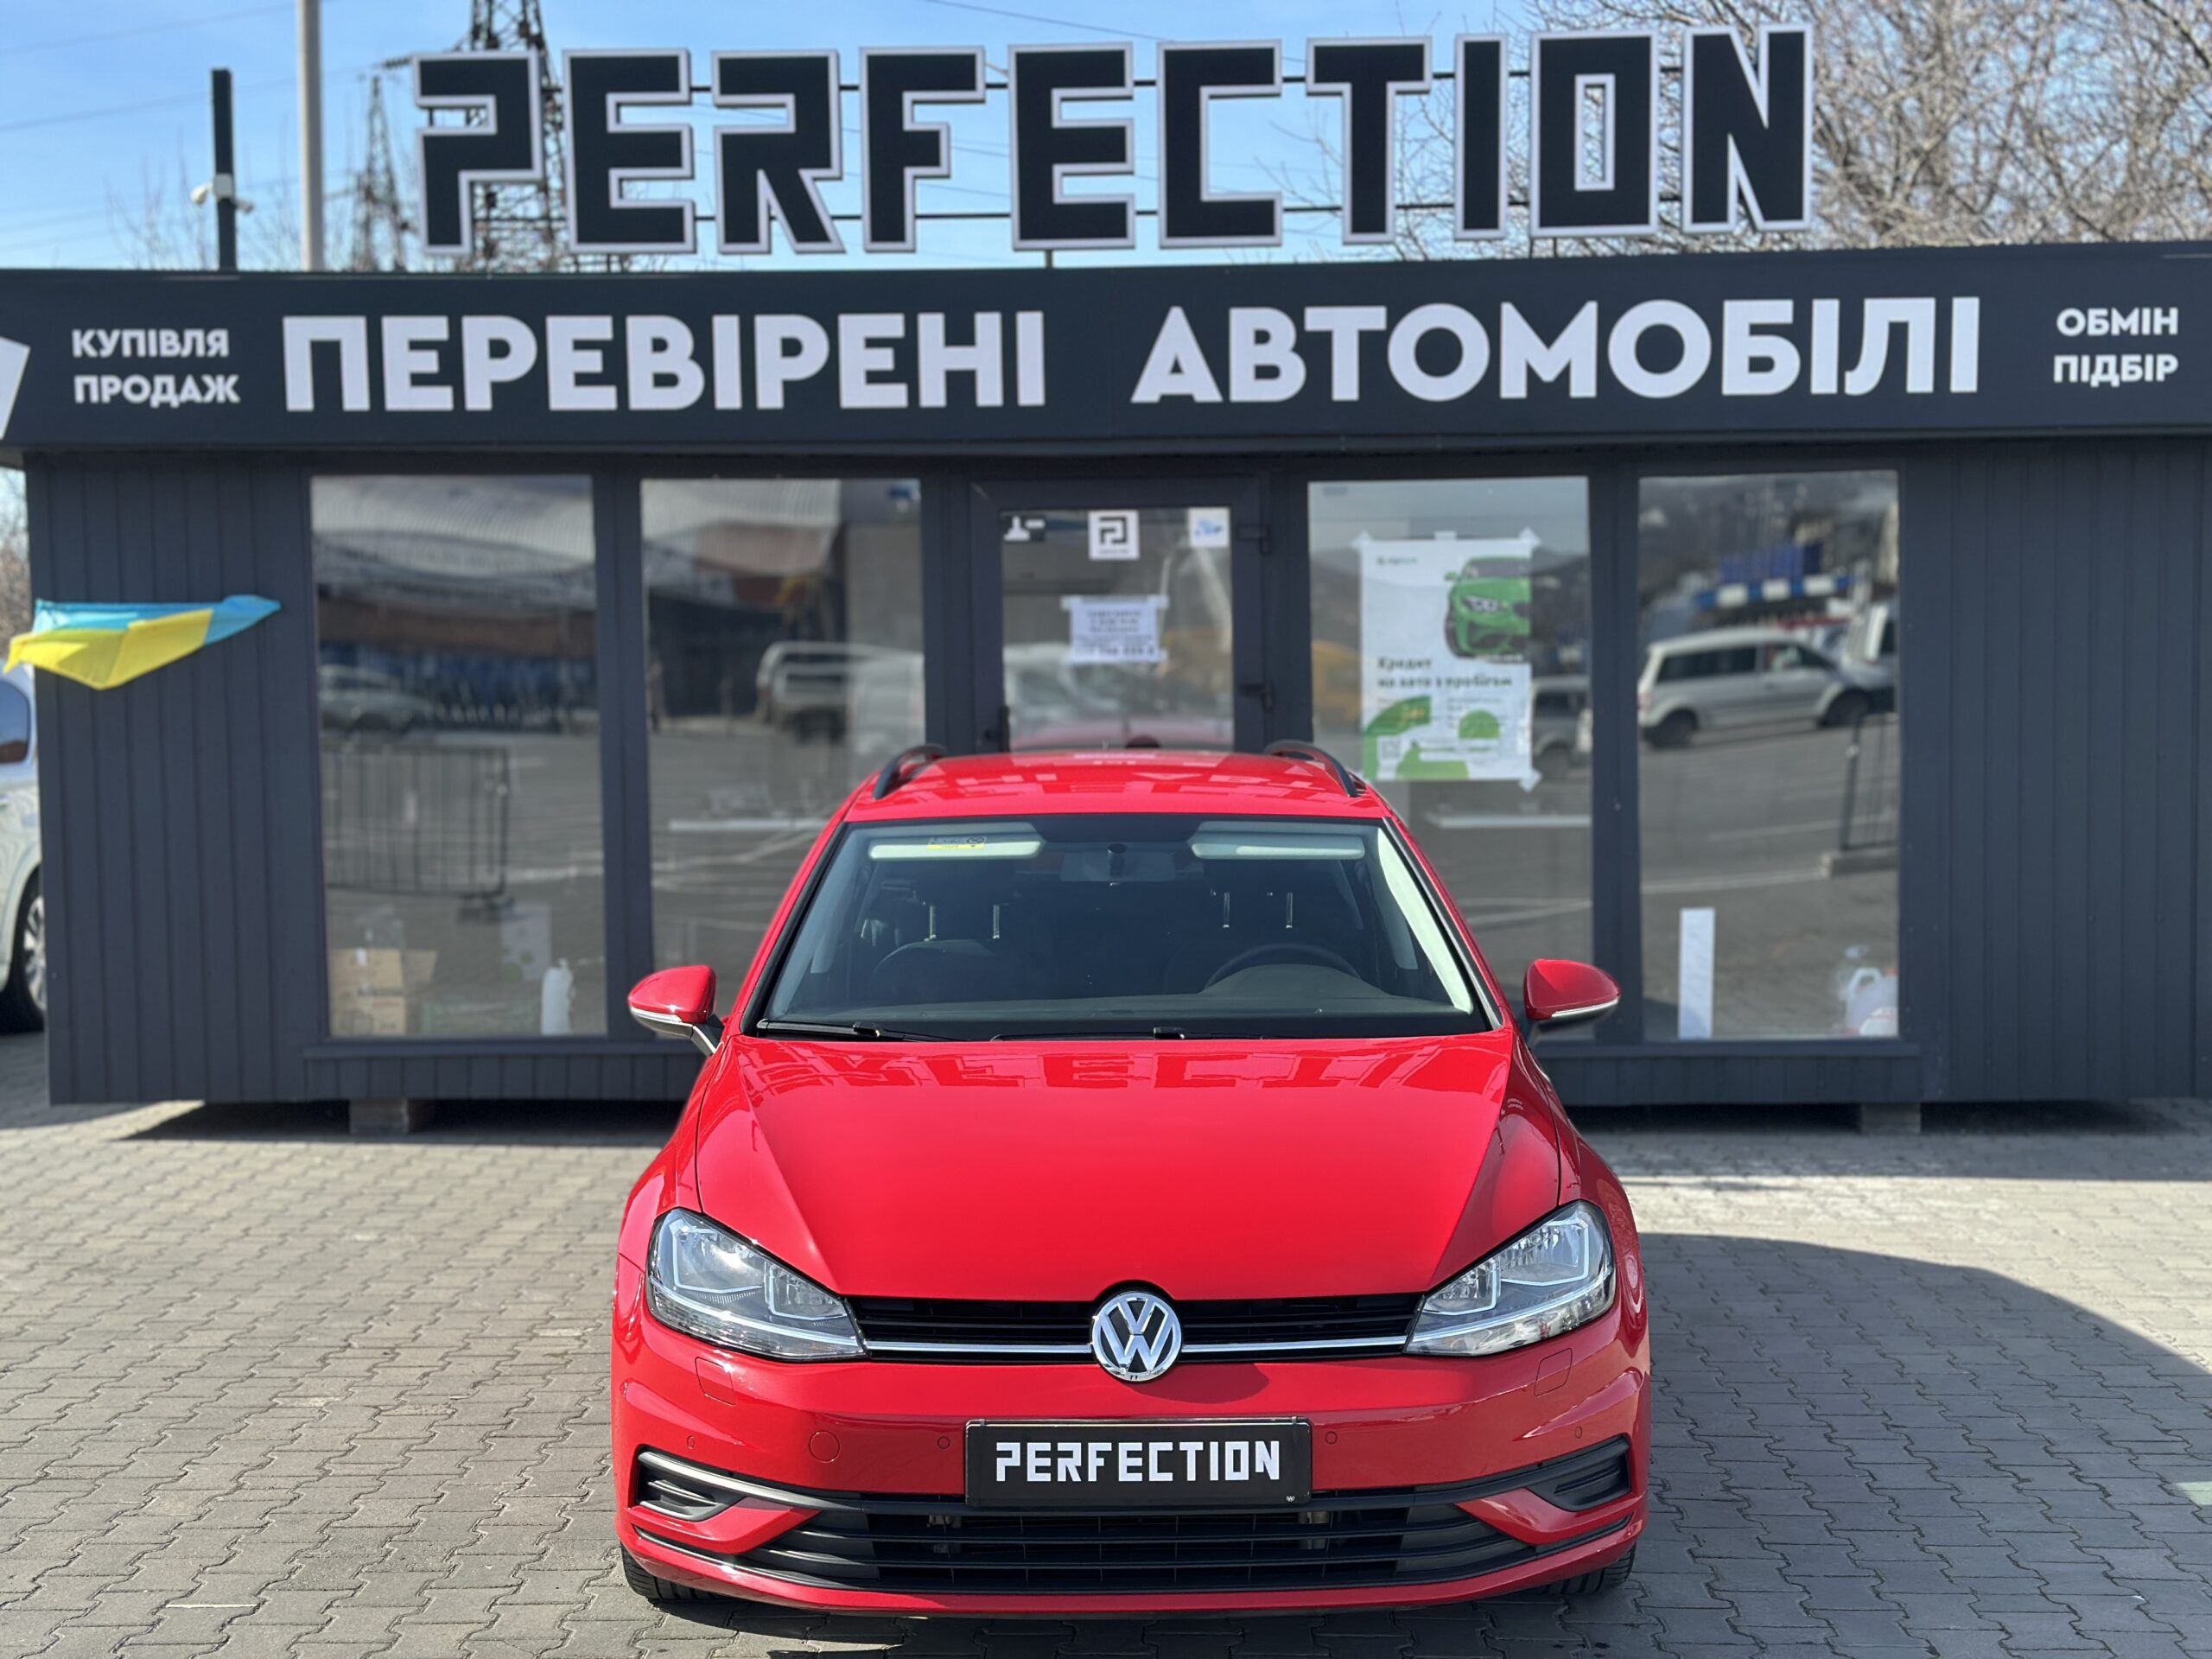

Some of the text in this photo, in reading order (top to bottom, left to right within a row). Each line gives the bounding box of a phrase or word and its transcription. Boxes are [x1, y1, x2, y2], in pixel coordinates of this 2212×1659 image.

[413, 23, 1814, 257] PERFECTION
[2056, 307, 2178, 337] ОБМІН
[73, 329, 229, 358] КУПІВЛЯ
[283, 296, 1980, 412] ПЕРЕВІРЕНІ АВТОМОБІЛІ
[2053, 353, 2178, 388] ПІДБІР
[74, 375, 239, 408] ПРОДАЖ
[996, 1440, 1280, 1482] PERFECTION
